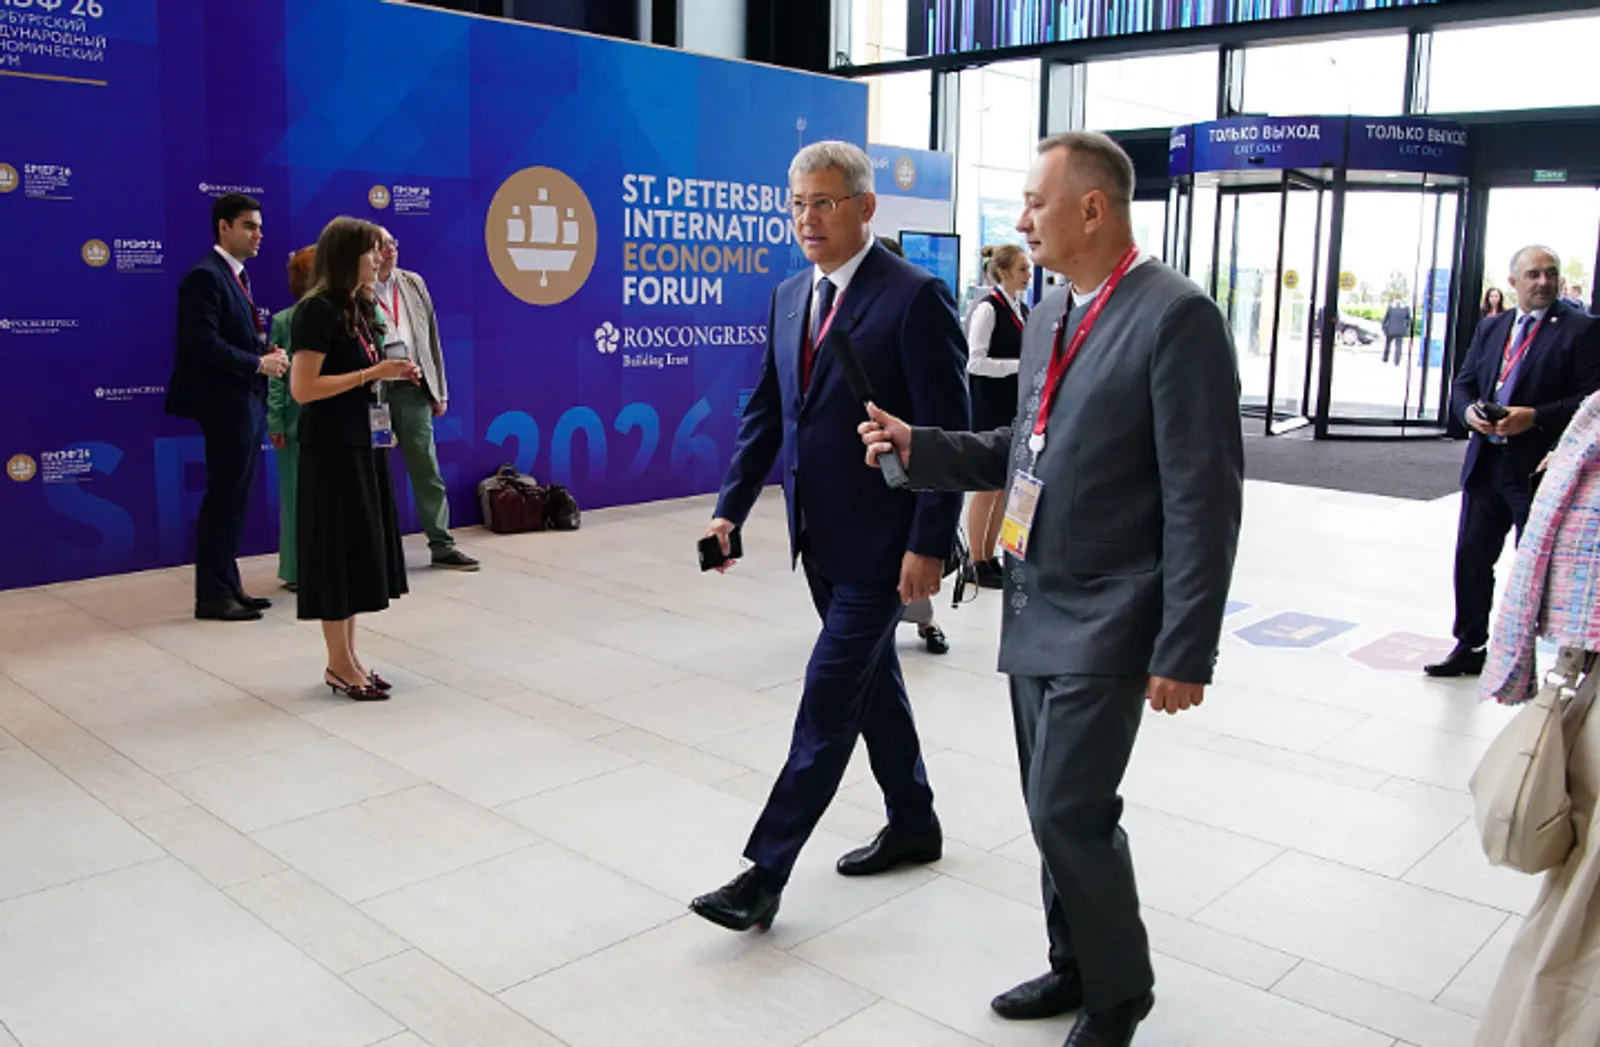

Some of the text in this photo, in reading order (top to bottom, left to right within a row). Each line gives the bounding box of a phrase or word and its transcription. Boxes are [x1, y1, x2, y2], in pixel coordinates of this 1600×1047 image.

[1208, 124, 1320, 142] ТОЛЬКО ВЫХОД
[1365, 124, 1424, 141] ТОЛЬКО
[622, 174, 660, 204] ST.
[623, 242, 769, 274] ECONOMIC
[622, 276, 723, 305] FORUM
[623, 325, 767, 348] ROSCONGRESS
[622, 352, 689, 369] Building Trust
